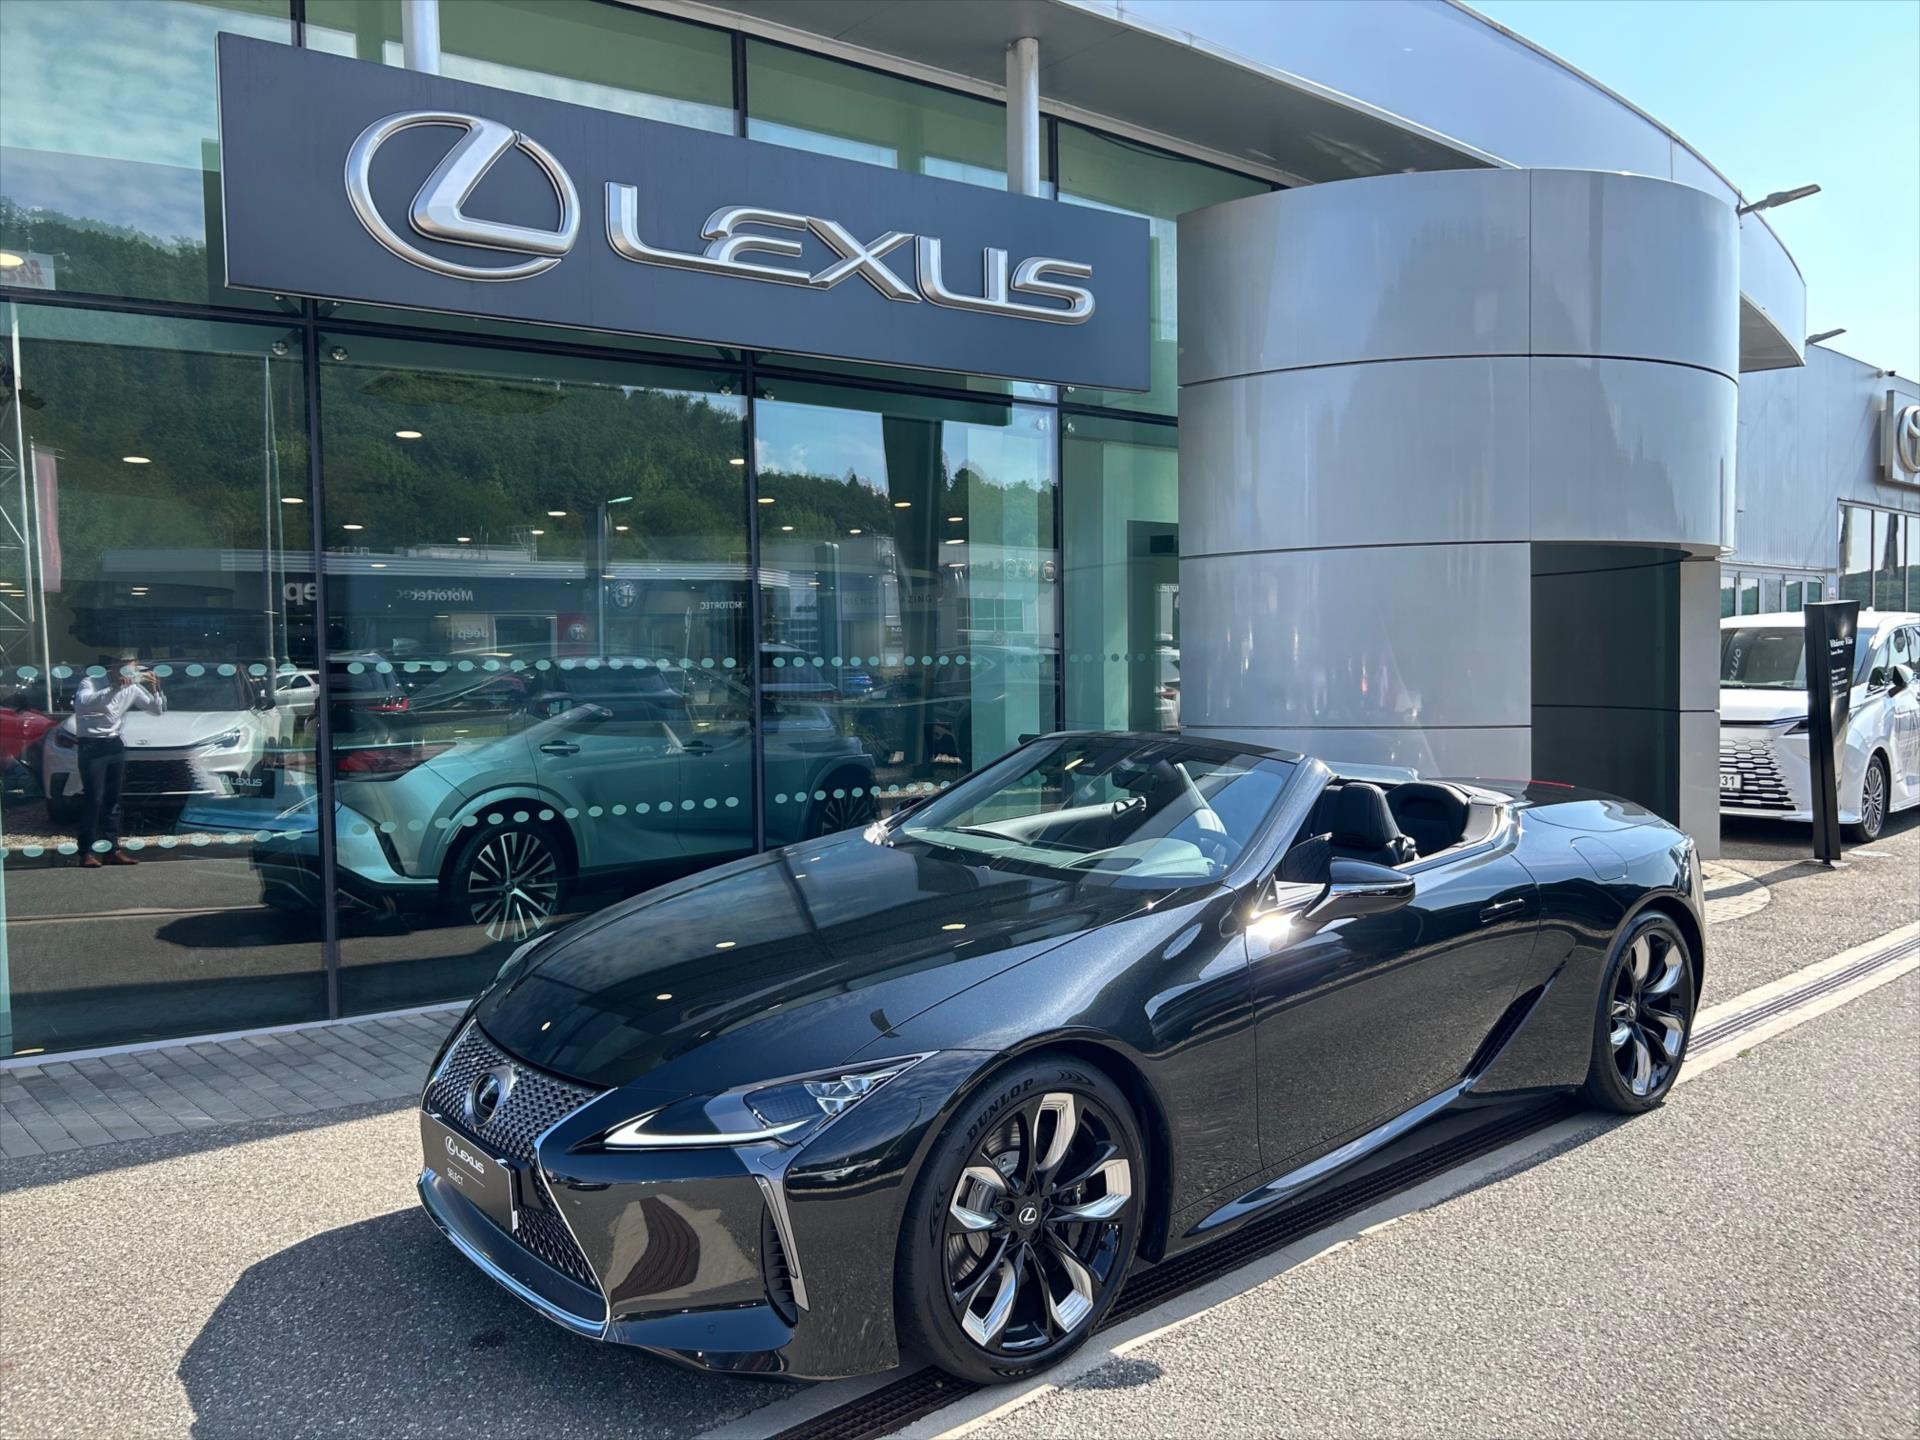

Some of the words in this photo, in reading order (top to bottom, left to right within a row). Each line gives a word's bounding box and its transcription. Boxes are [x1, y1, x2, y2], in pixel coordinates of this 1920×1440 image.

[604, 181, 1096, 326] LEXUS
[231, 777, 263, 787] LEXUS
[967, 1077, 1035, 1142] DUNLOP
[455, 1145, 485, 1175] LEXUS
[447, 1167, 464, 1186] SELECT
